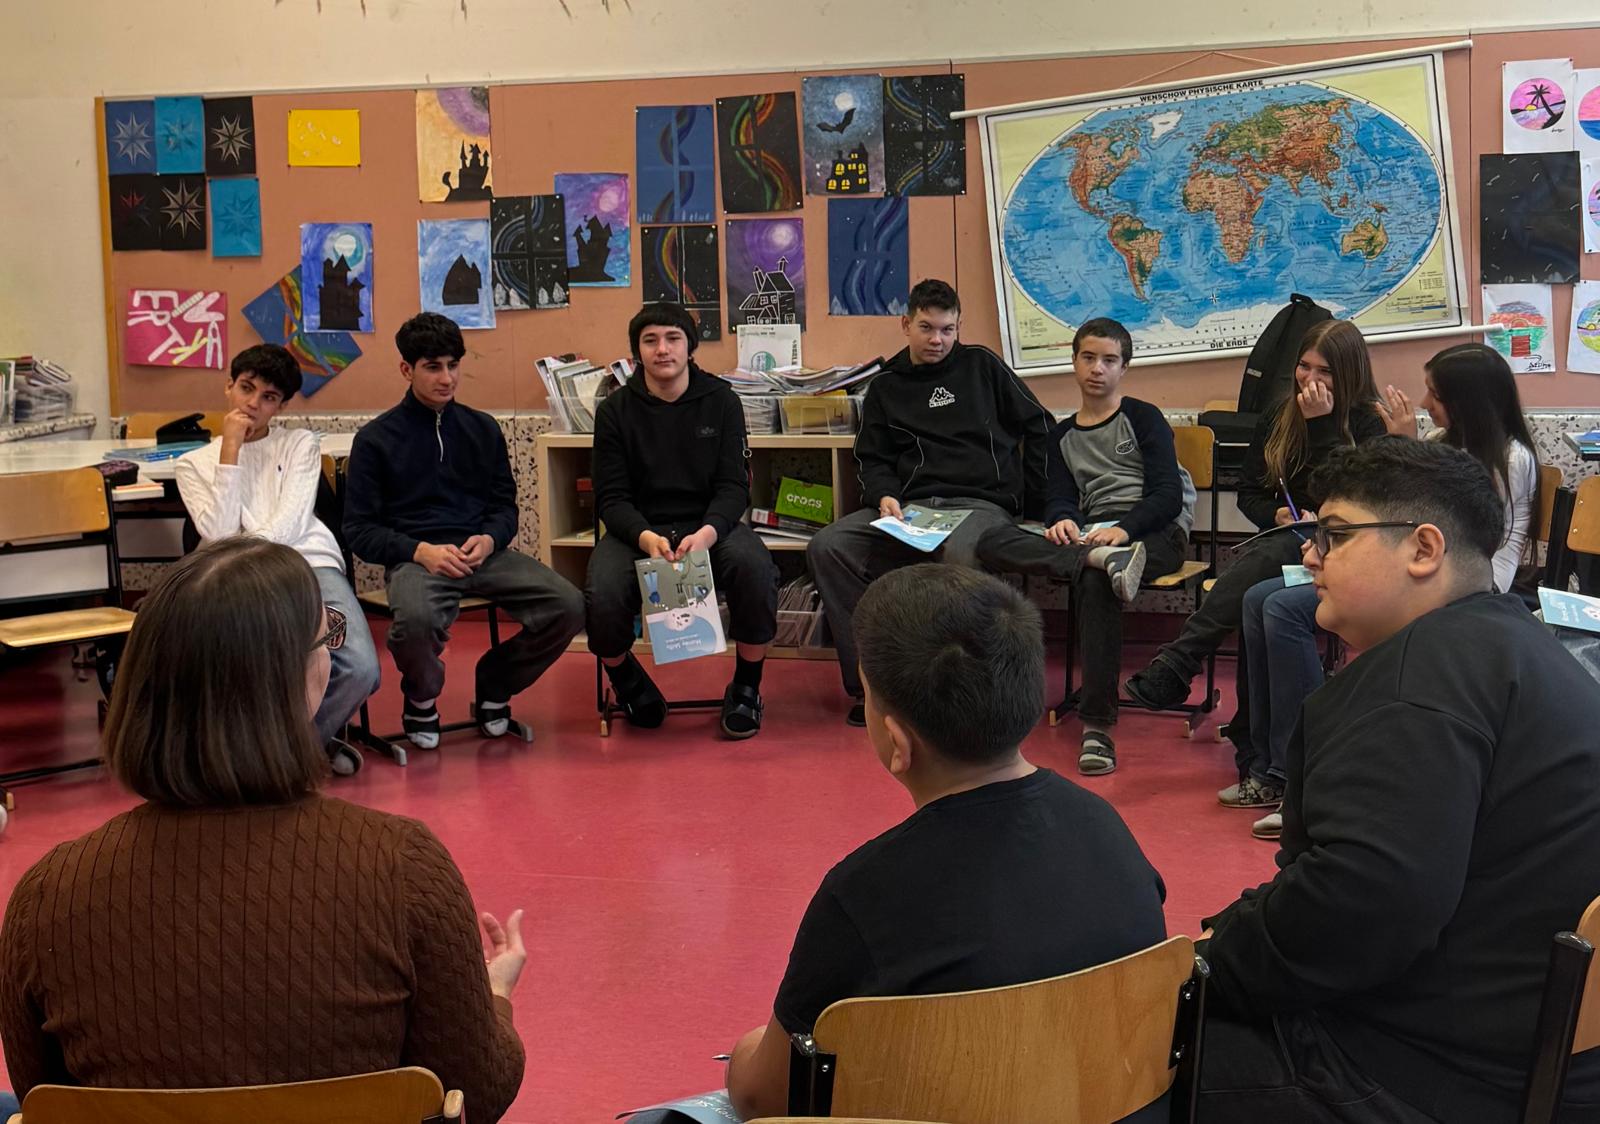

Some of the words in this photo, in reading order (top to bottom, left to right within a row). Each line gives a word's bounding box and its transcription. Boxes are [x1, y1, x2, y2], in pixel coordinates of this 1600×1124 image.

[1140, 90, 1186, 102] WENSCHOW
[1188, 84, 1234, 96] PHYSISCHE
[1236, 79, 1264, 89] KARTE
[1210, 341, 1224, 349] DIE
[786, 493, 822, 509] crocs
